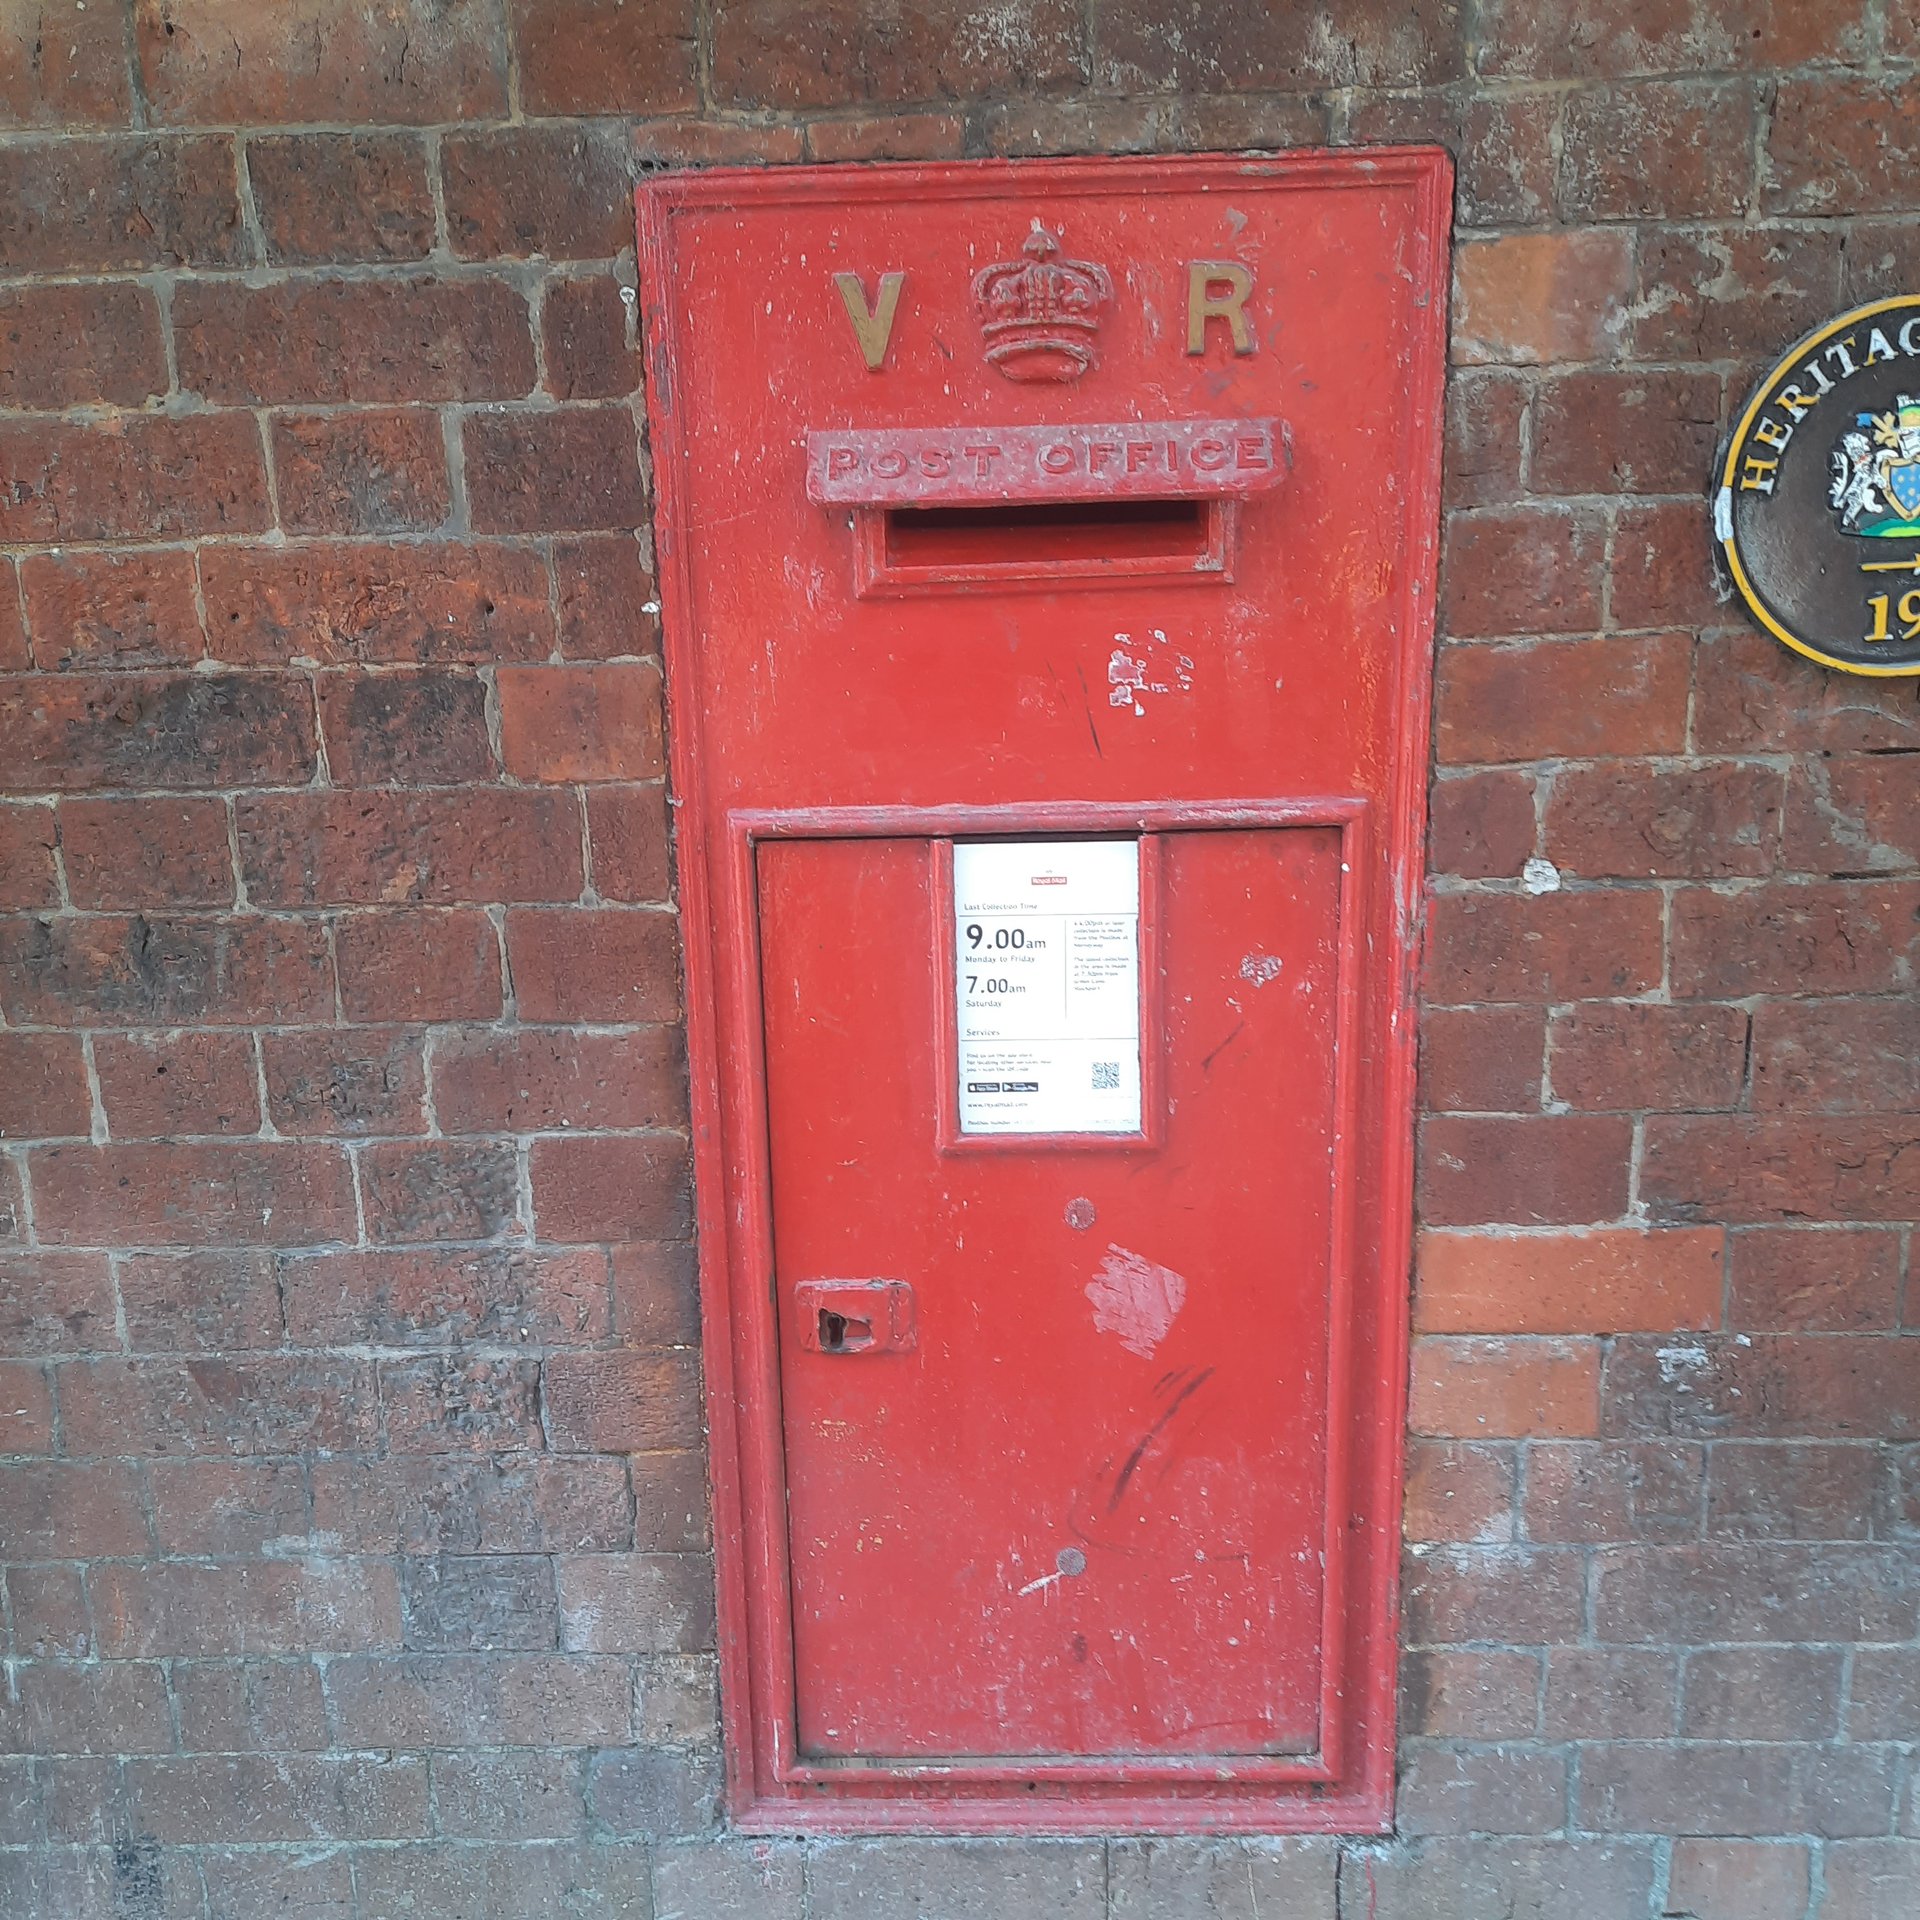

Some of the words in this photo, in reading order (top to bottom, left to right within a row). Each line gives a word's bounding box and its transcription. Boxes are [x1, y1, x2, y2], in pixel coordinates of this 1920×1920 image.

[834, 272, 906, 371] V
[1187, 261, 1254, 355] R
[827, 446, 1001, 481] POST
[1038, 437, 1270, 475] OFFICE
[966, 924, 1046, 949] 9.00am
[965, 975, 1026, 994] 7.00am
